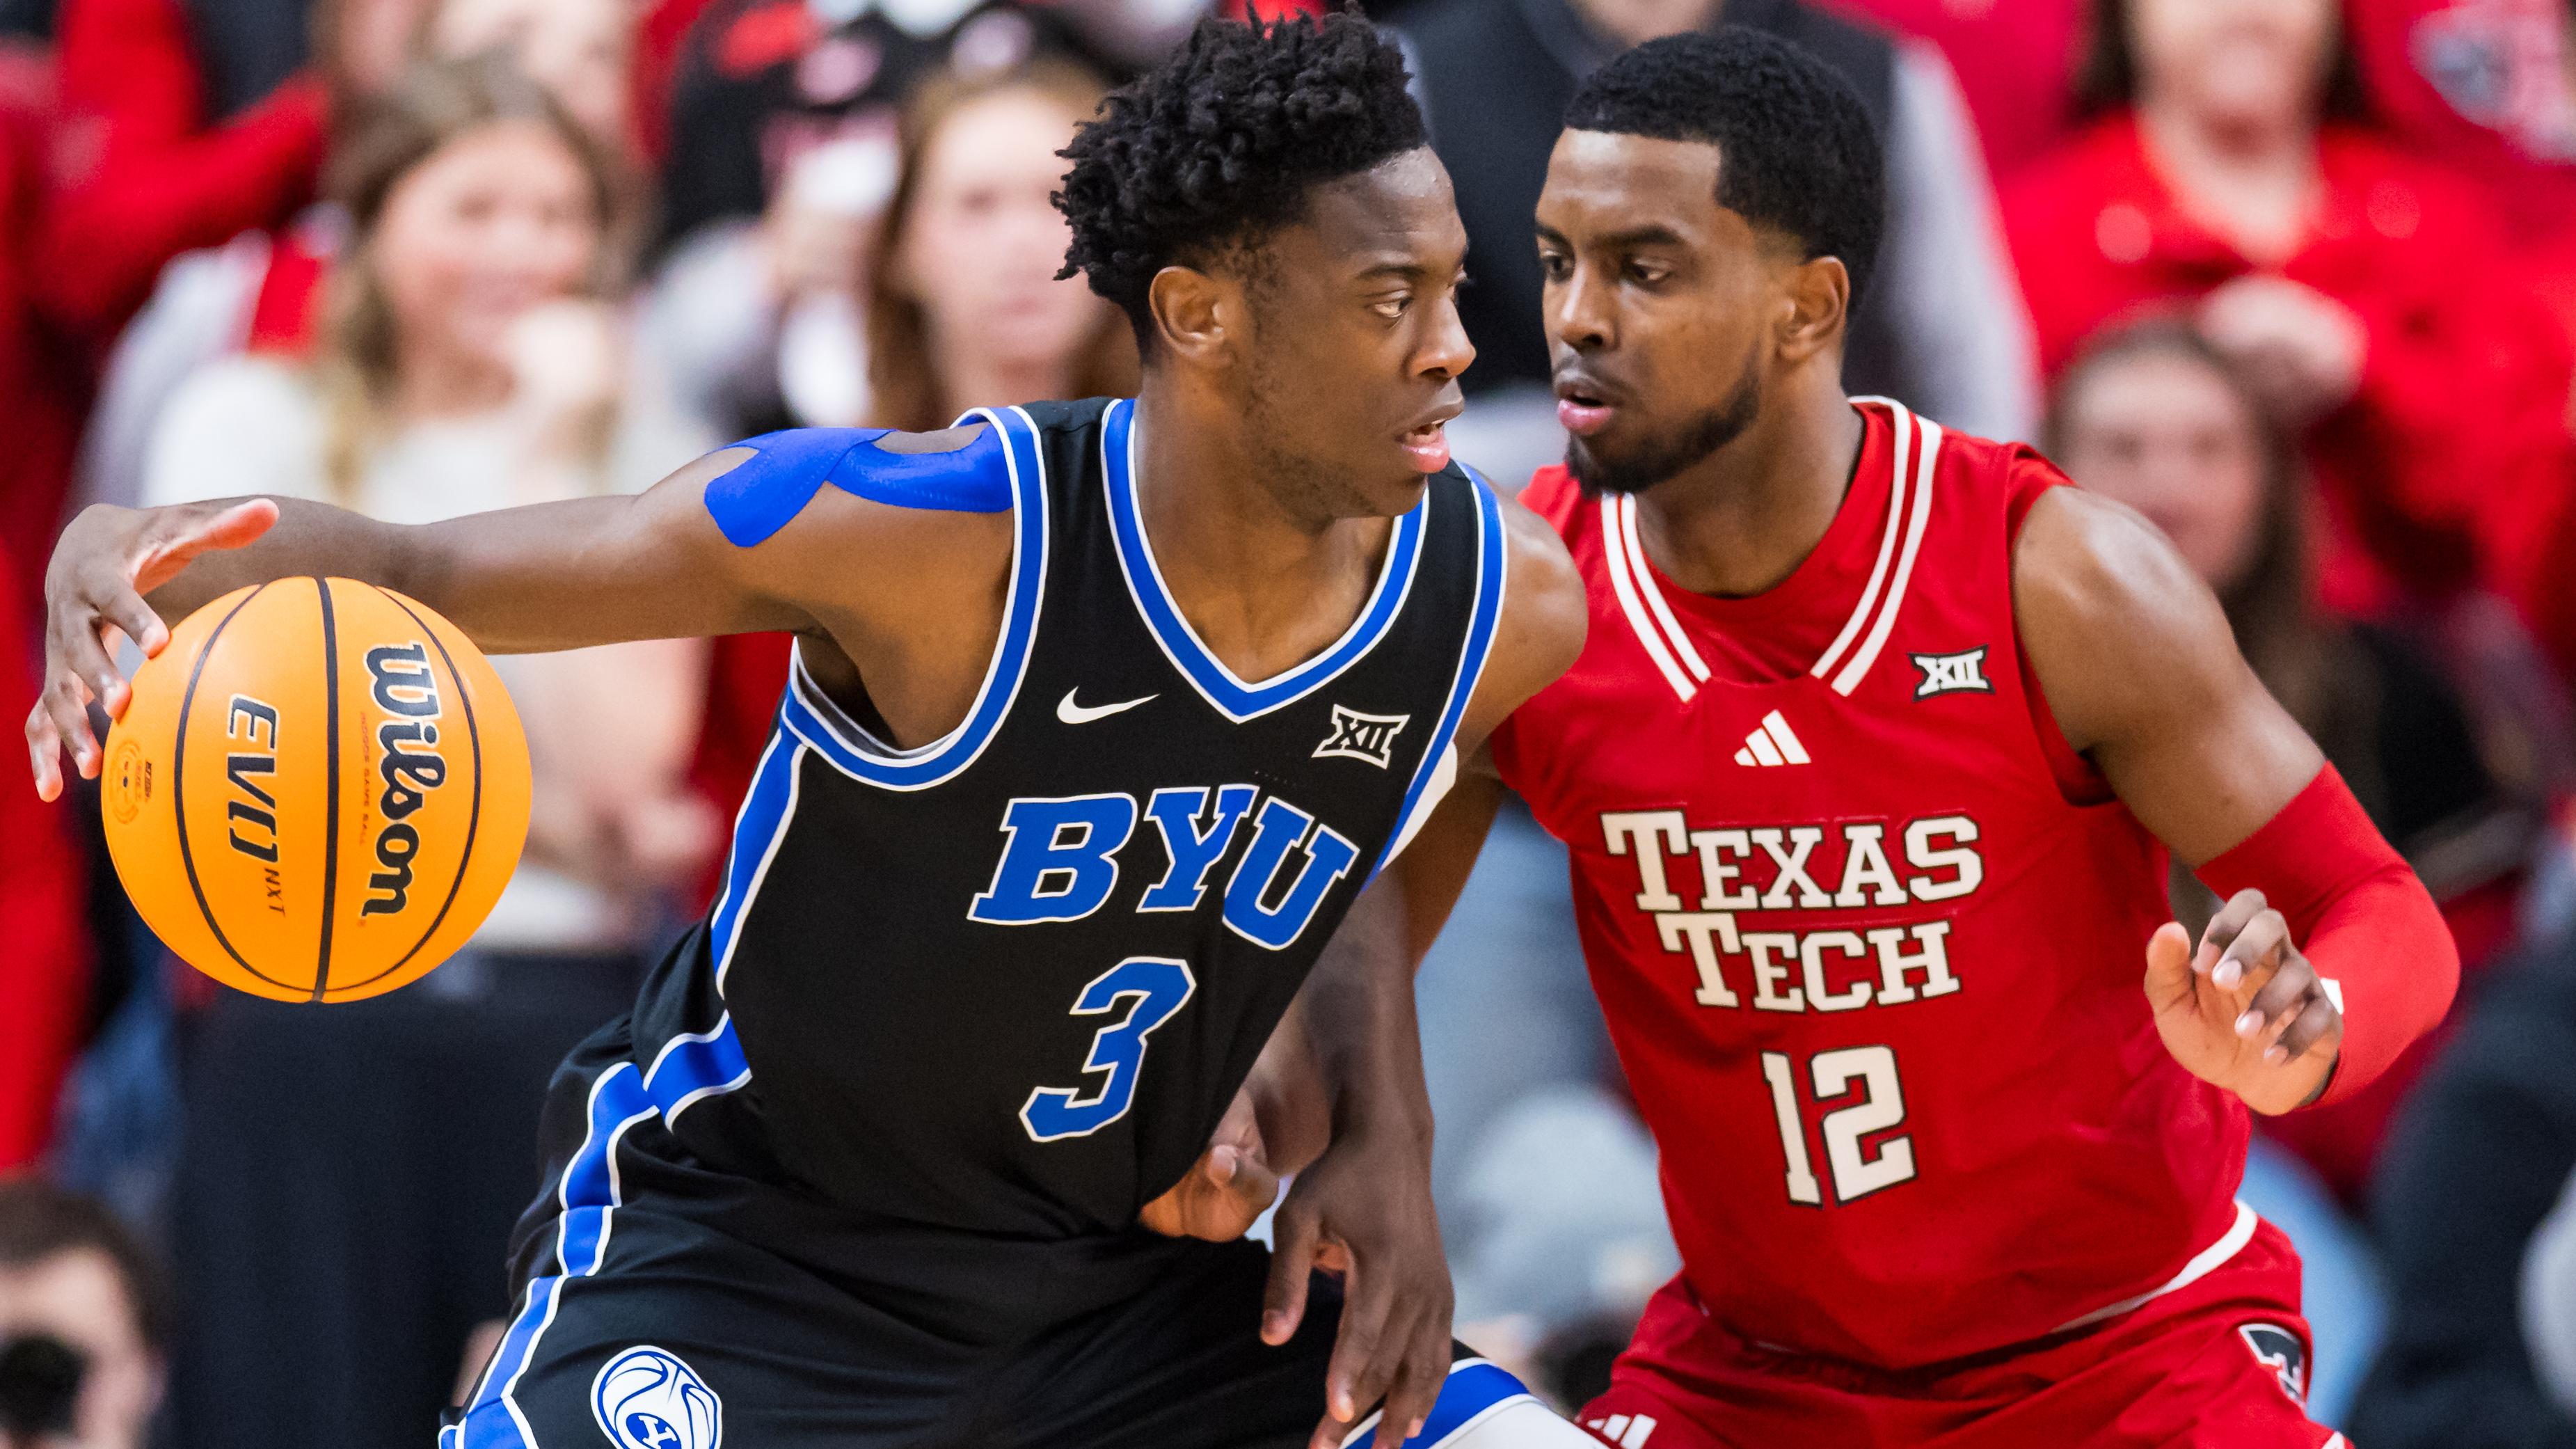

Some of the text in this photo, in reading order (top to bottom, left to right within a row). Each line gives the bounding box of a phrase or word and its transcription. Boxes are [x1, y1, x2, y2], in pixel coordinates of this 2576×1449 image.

[1315, 707, 1407, 766] XII
[1911, 646, 1993, 699] XII
[226, 692, 286, 917] EVO NXT
[361, 640, 445, 917] Wilson
[1600, 809, 1985, 911] TEXAS
[967, 784, 1360, 951] BYU
[1655, 910, 1962, 1014] TECH
[1019, 956, 1197, 1142] 3
[1760, 1044, 1918, 1210] 12
